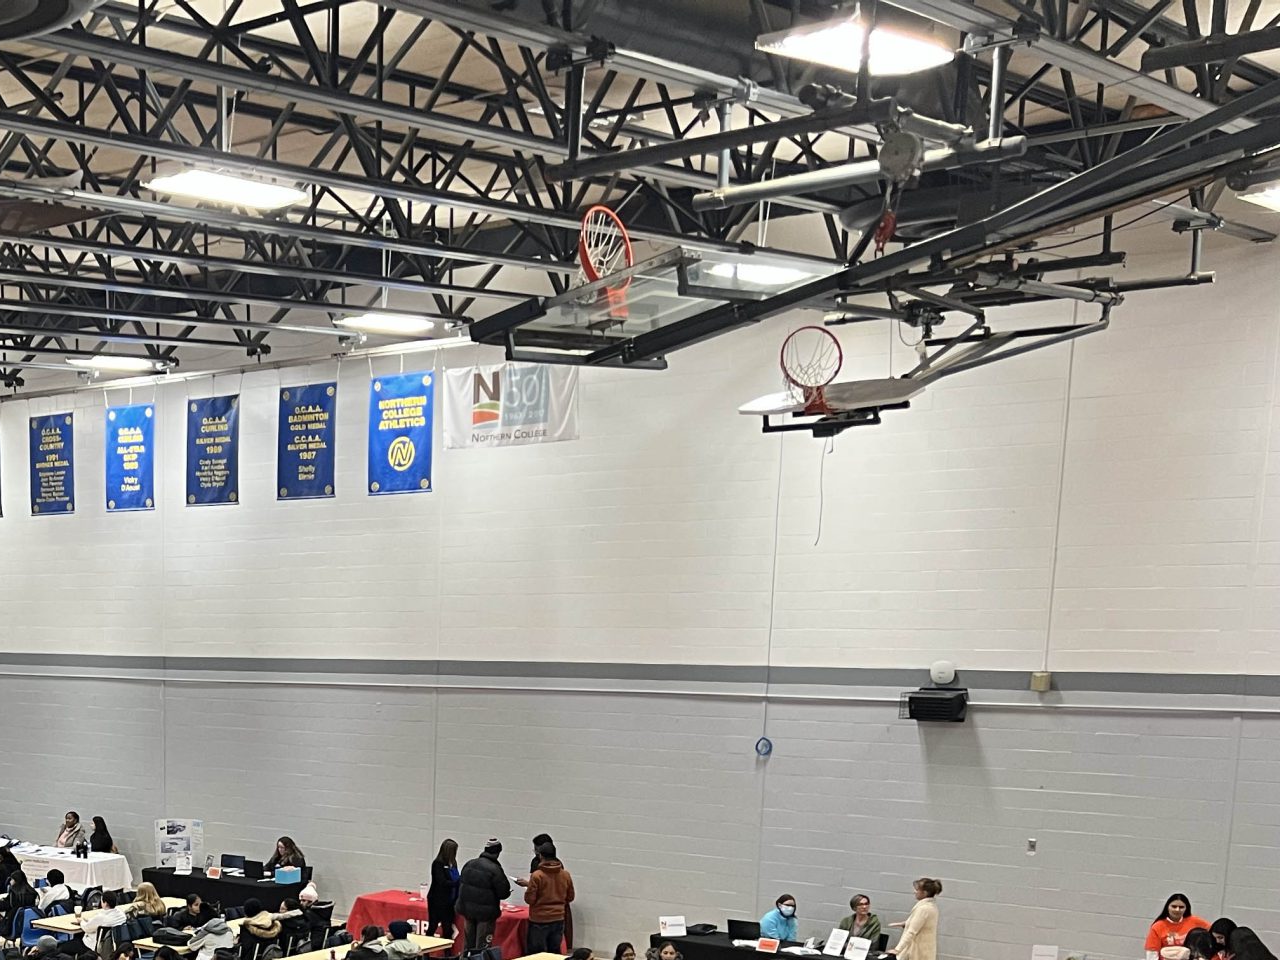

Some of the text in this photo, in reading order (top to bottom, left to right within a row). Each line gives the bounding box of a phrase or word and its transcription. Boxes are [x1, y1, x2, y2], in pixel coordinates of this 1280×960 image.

[473, 371, 500, 404] N
[378, 395, 427, 409] NORTHERN
[288, 412, 329, 423] BADMINTON
[382, 406, 423, 420] COLLEGE
[307, 422, 326, 430] MEDAL
[378, 416, 426, 430] ATHLETICS
